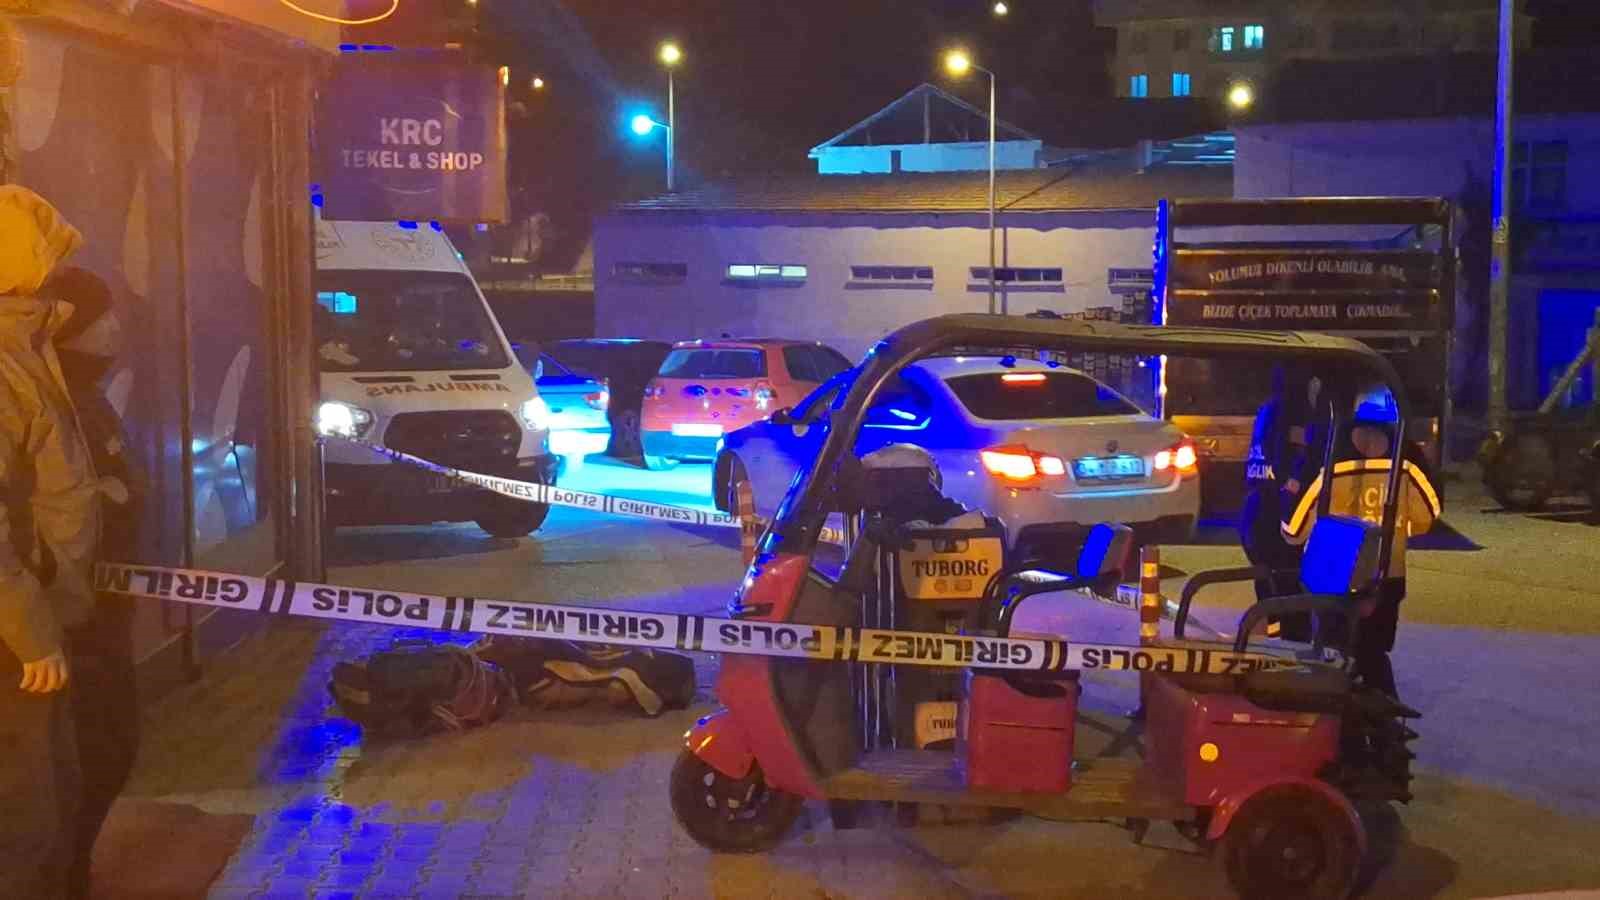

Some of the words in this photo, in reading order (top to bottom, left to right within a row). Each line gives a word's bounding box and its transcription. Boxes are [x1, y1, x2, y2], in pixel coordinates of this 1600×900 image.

[380, 117, 443, 146] KRC
[342, 149, 405, 169] TEKEL
[409, 152, 422, 169] &
[427, 151, 483, 171] SHOP
[911, 559, 989, 577] TUBORG
[312, 587, 430, 621] POLİS
[486, 603, 665, 641] GİRİLMEZ
[718, 623, 822, 653] POLİS
[872, 634, 1033, 665] GİRİLMEZ
[1082, 648, 1175, 673] POLİS
